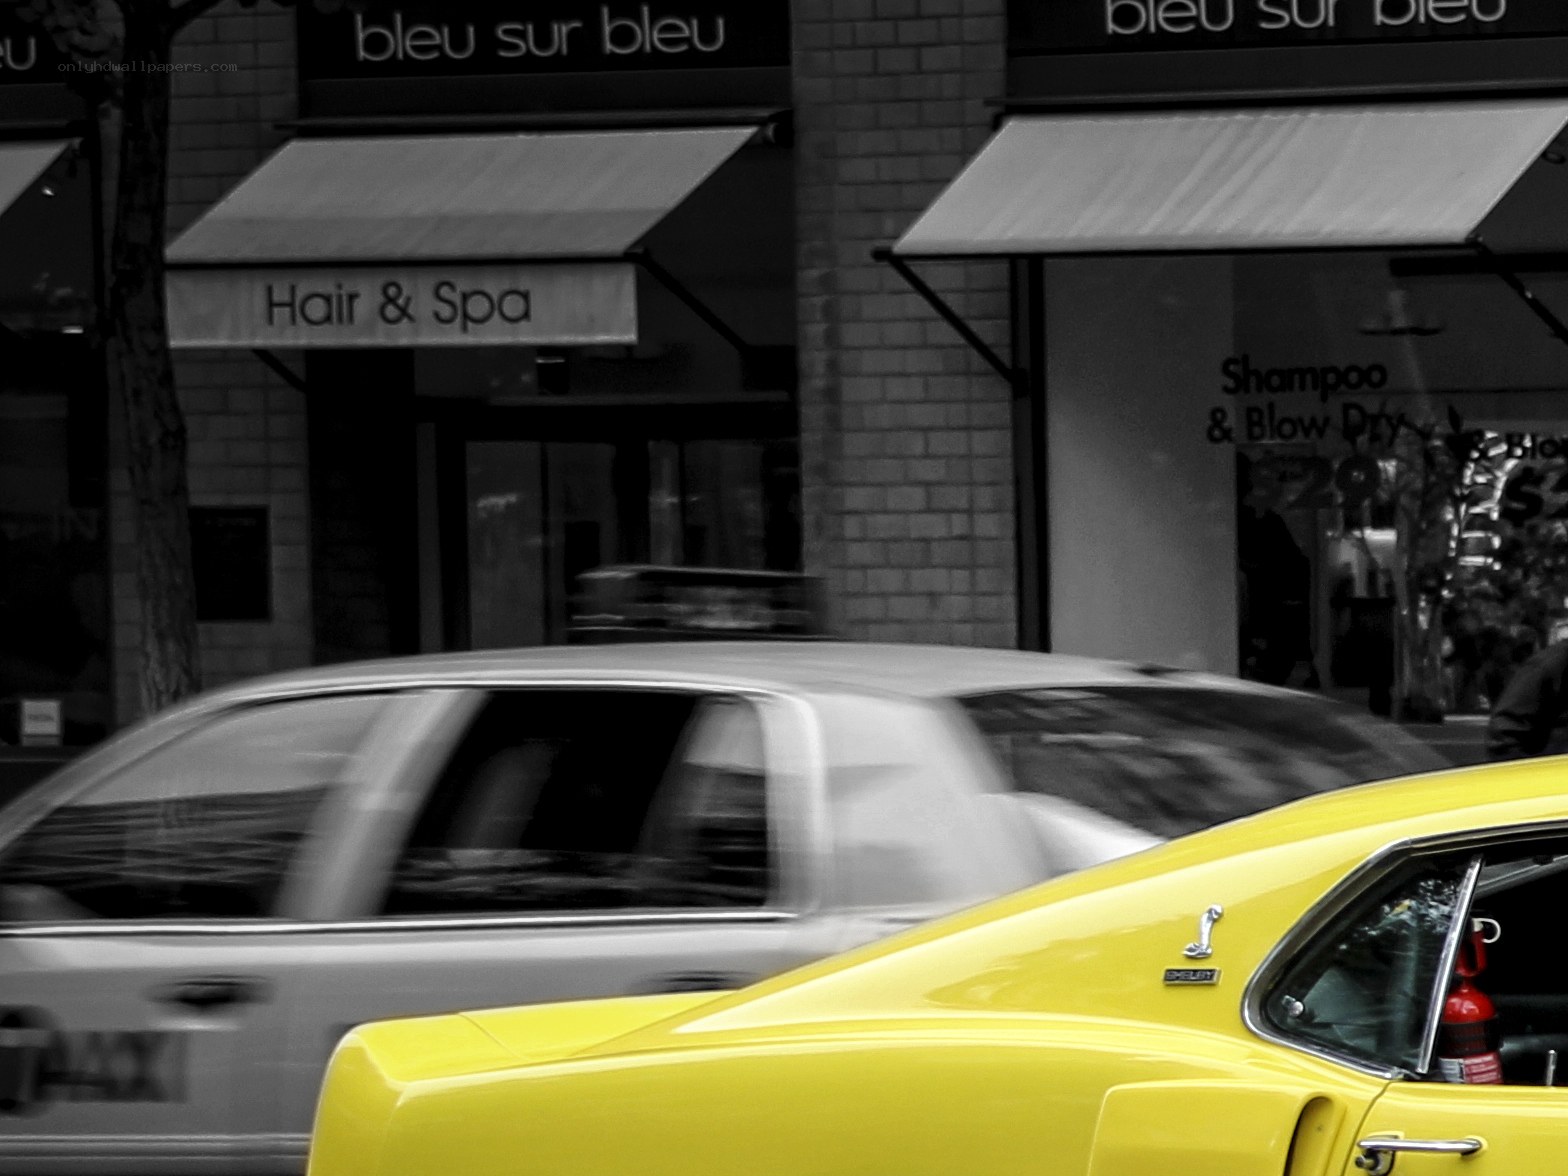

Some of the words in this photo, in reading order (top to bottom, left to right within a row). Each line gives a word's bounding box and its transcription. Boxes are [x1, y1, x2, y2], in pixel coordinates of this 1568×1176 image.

[353, 8, 476, 62] bleu
[494, 19, 584, 58] sur
[601, 2, 726, 56] bleu
[267, 283, 360, 326] Hair
[379, 281, 416, 324] &
[433, 281, 531, 333] Spa
[1222, 354, 1388, 402] Shampoo
[1208, 407, 1233, 442] &
[1246, 403, 1330, 441] Blow
